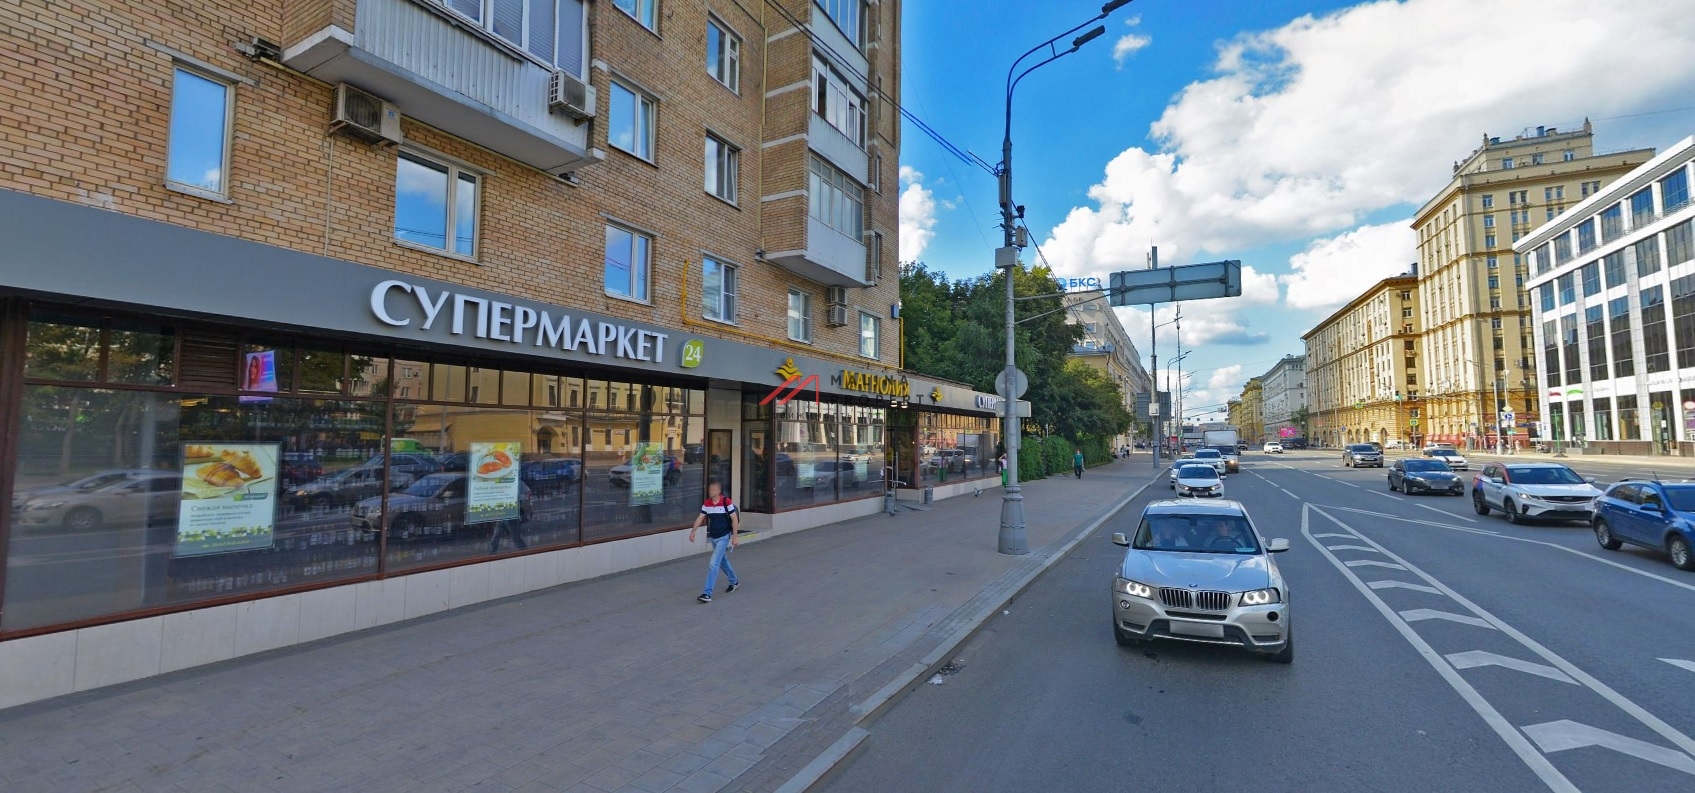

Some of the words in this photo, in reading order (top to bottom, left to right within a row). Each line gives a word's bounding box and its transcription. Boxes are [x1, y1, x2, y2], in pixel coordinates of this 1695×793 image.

[1070, 277, 1096, 288] БКС
[370, 280, 669, 363] СУПЕРМАРКЕТ
[684, 343, 702, 362] 24
[841, 370, 910, 397] МАГНОЛИЯ
